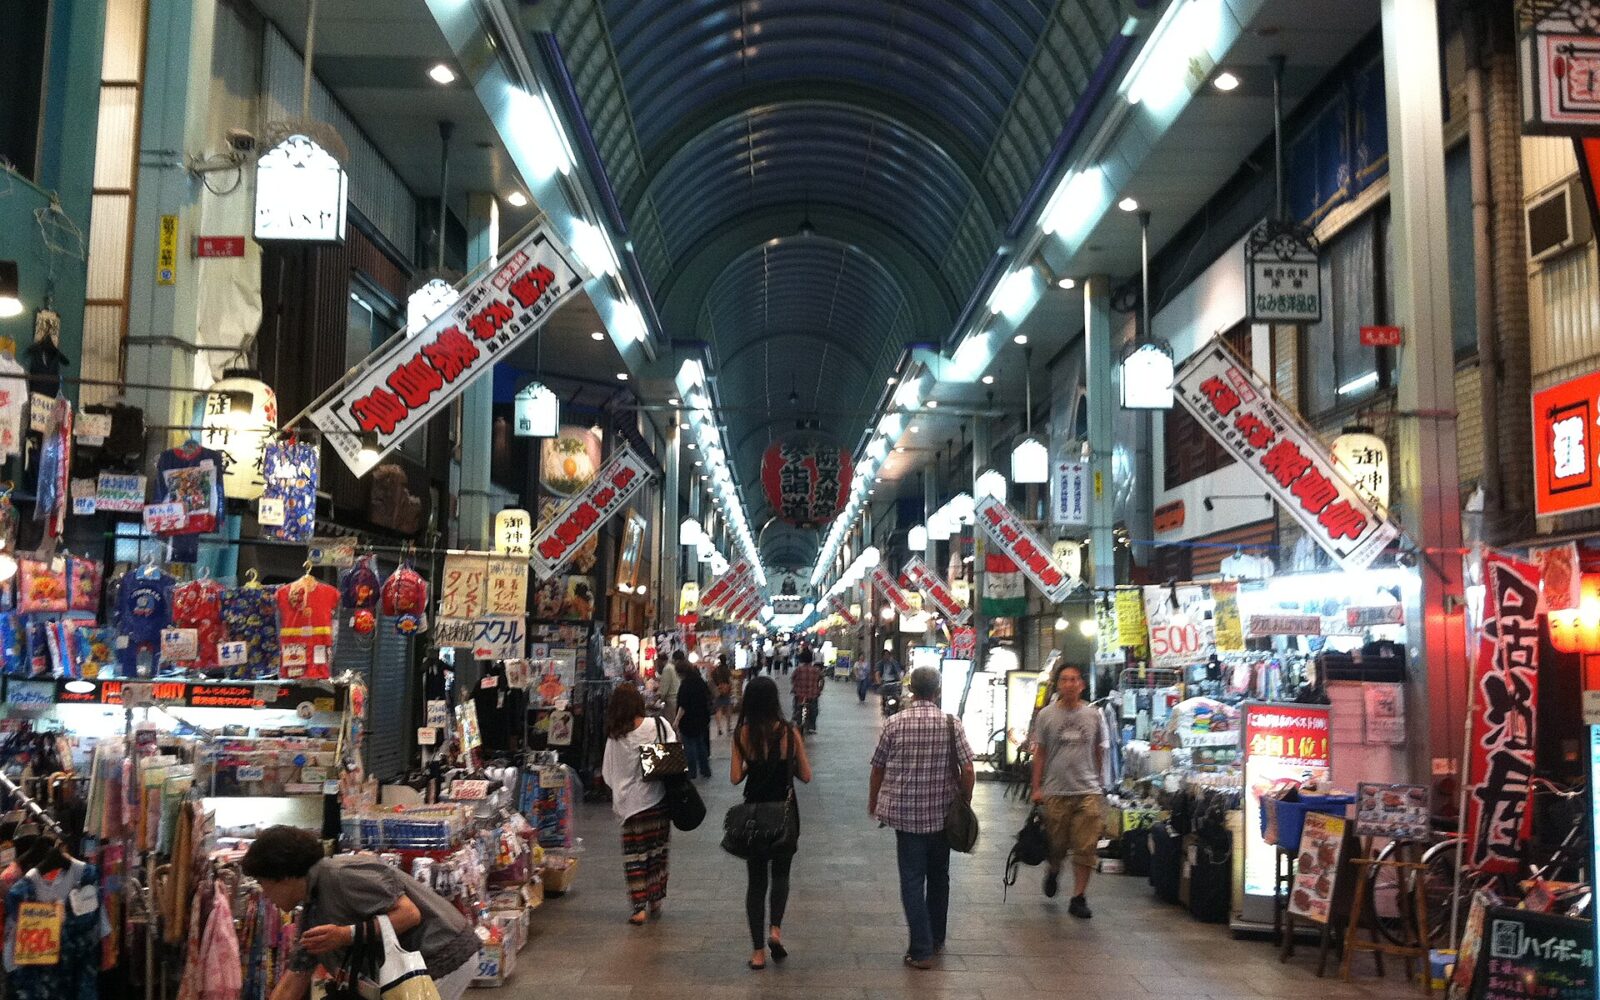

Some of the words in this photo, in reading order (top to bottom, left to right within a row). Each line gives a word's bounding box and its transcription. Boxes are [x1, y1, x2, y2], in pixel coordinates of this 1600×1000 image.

[475, 620, 524, 646] スクール
[1151, 623, 1200, 657] 500
